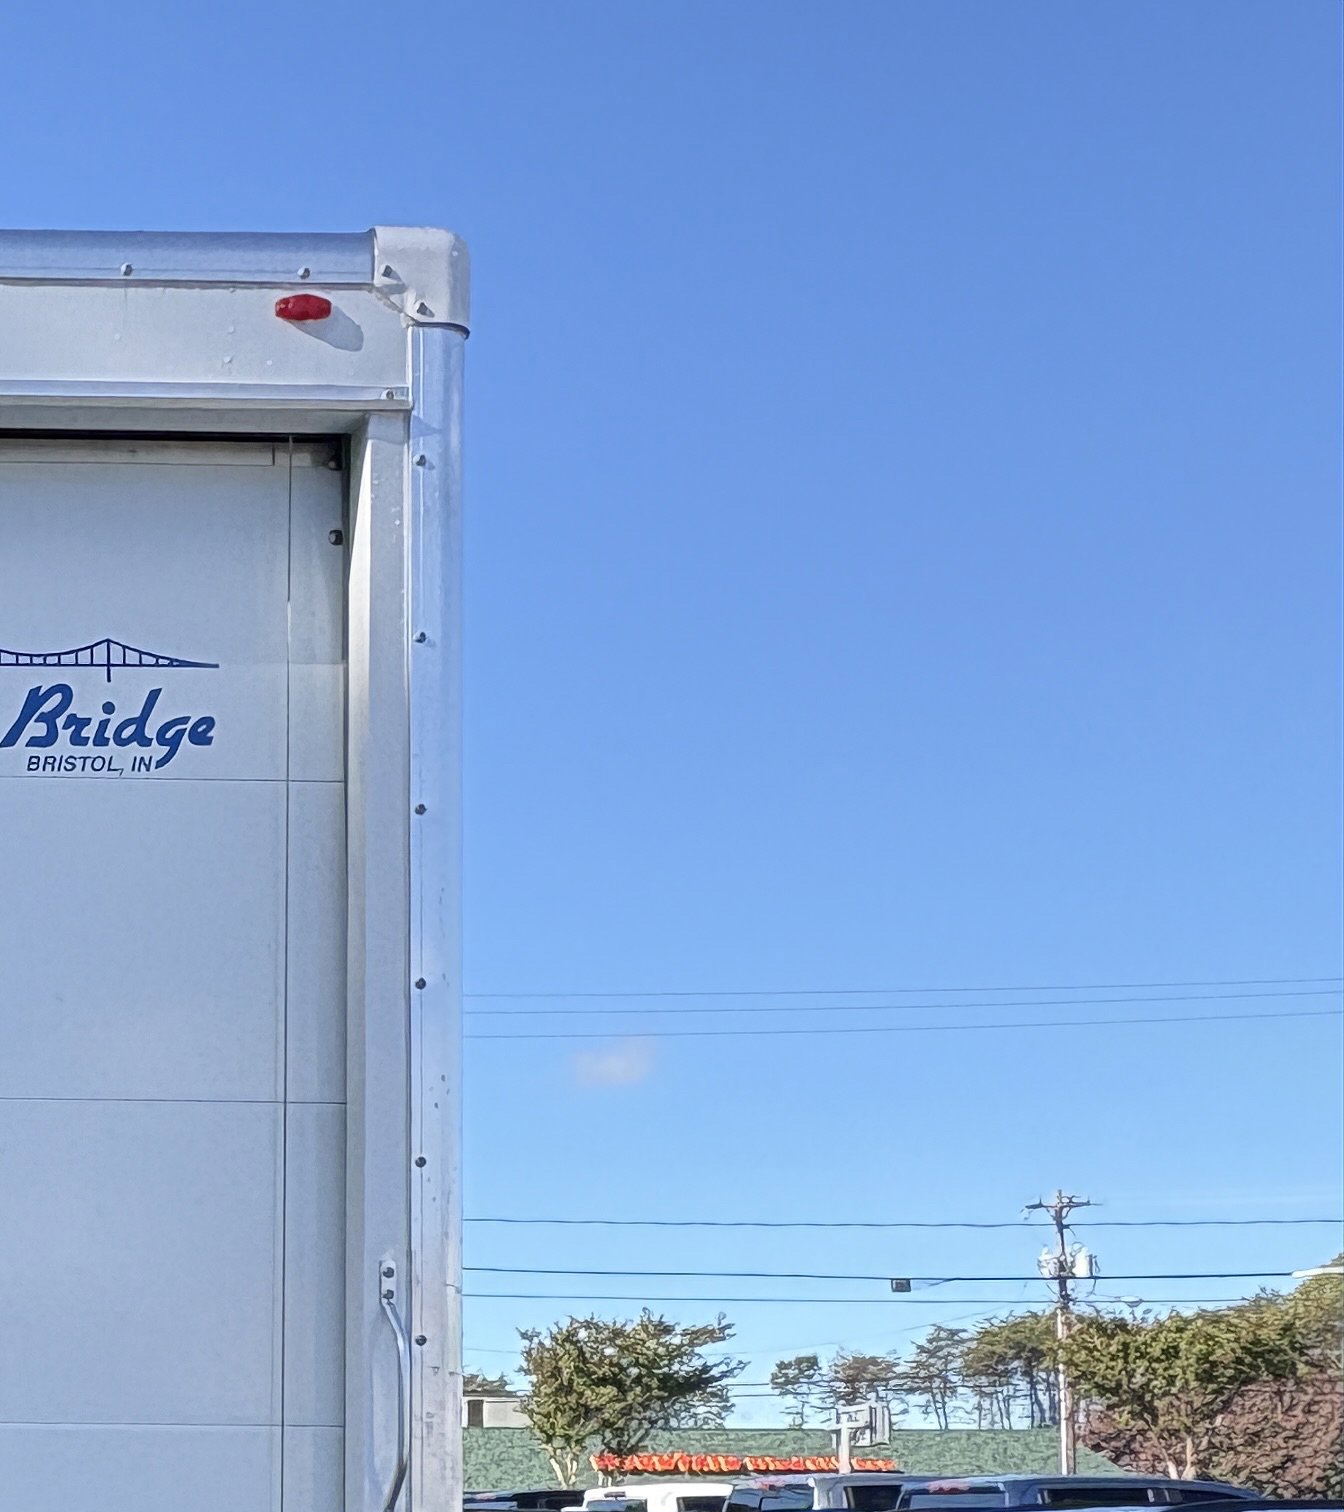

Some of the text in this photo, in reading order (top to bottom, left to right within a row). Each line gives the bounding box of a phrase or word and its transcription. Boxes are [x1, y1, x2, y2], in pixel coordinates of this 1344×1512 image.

[0, 683, 216, 769] Bridge
[27, 756, 153, 776] BRISTOL, IN
